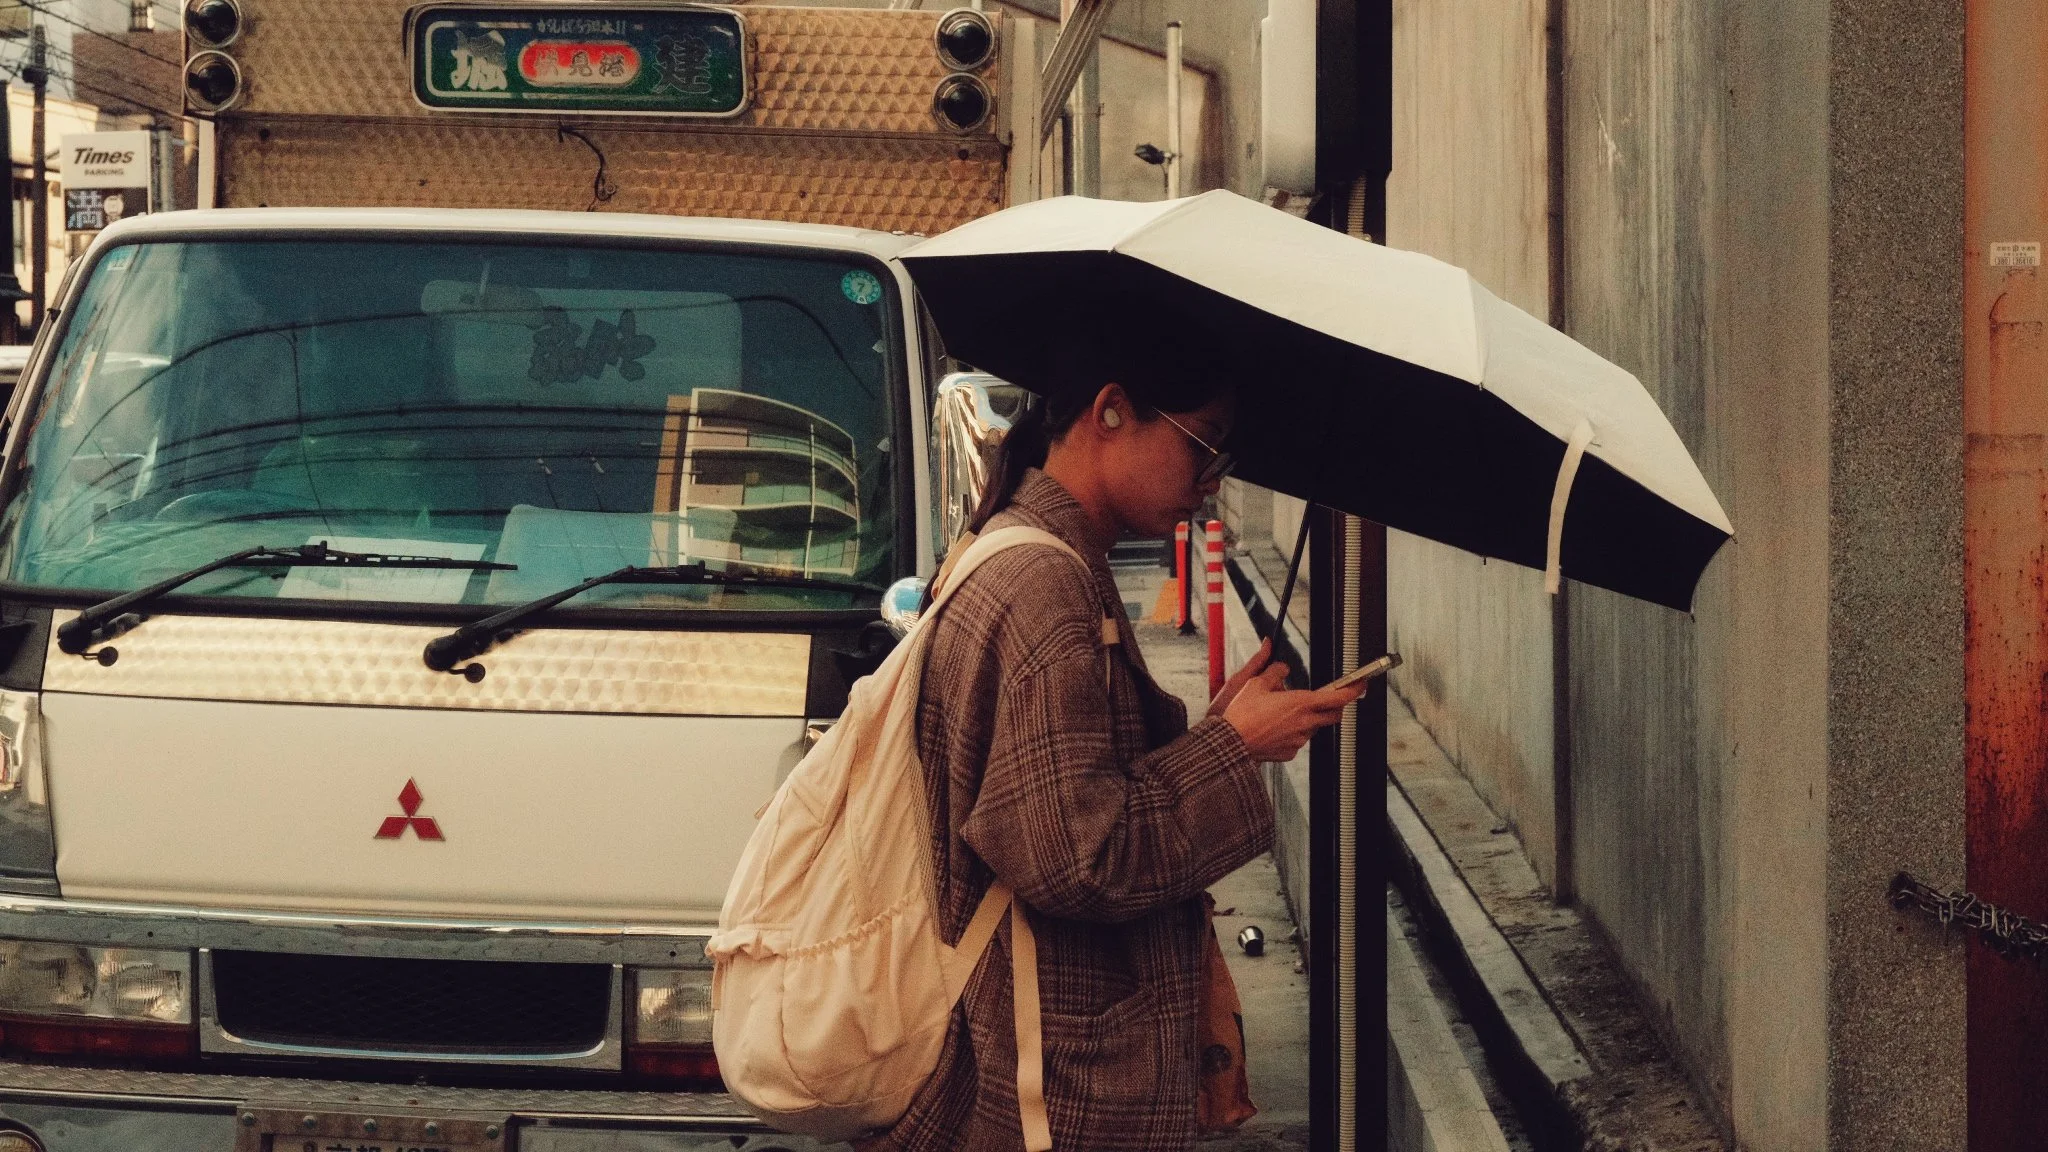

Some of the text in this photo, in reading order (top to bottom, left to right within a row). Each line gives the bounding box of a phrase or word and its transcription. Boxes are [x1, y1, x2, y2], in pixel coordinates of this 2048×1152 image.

[74, 147, 135, 165] Times
[84, 168, 125, 176] PARKING
[67, 190, 103, 229] 満
[857, 283, 865, 293] 7
